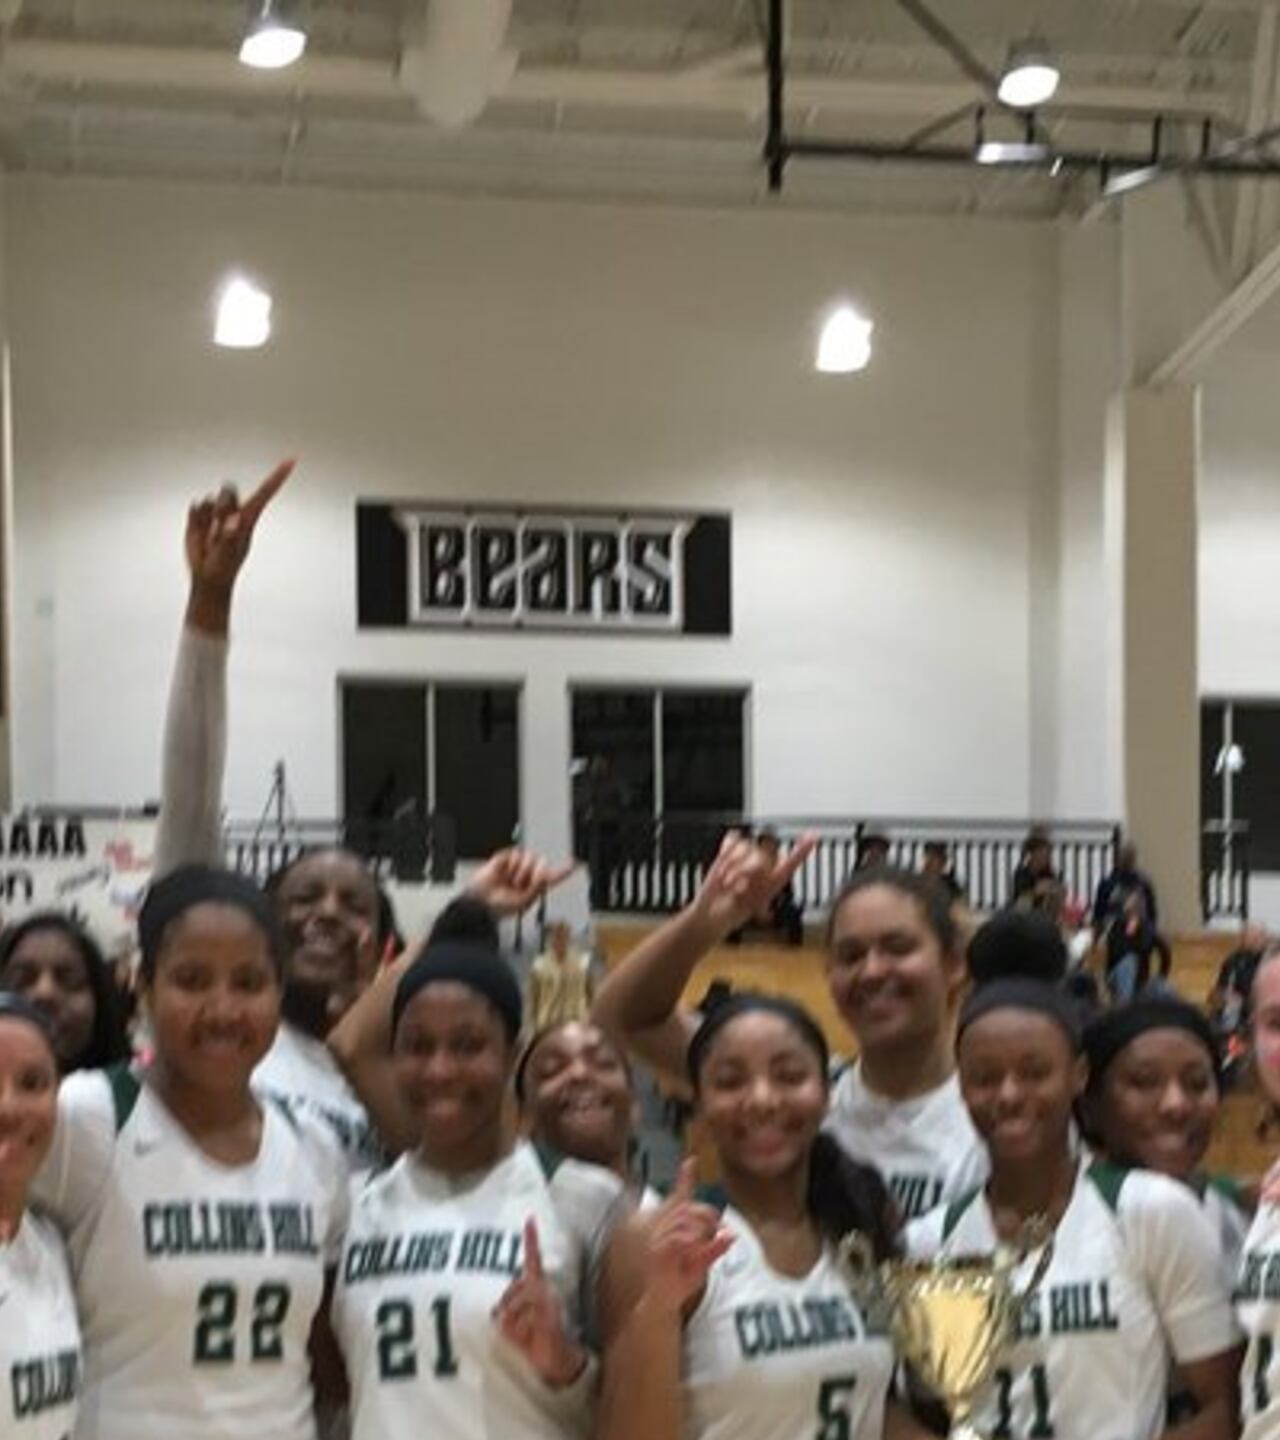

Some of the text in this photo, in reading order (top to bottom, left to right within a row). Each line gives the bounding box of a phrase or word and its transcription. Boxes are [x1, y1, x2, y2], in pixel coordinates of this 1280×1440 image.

[143, 1201, 319, 1257] COLLINS HILL
[344, 1227, 523, 1286] COLLINS HILL
[192, 1278, 291, 1366] 22
[1049, 1279, 1119, 1334] HILL
[375, 1295, 459, 1382] 21
